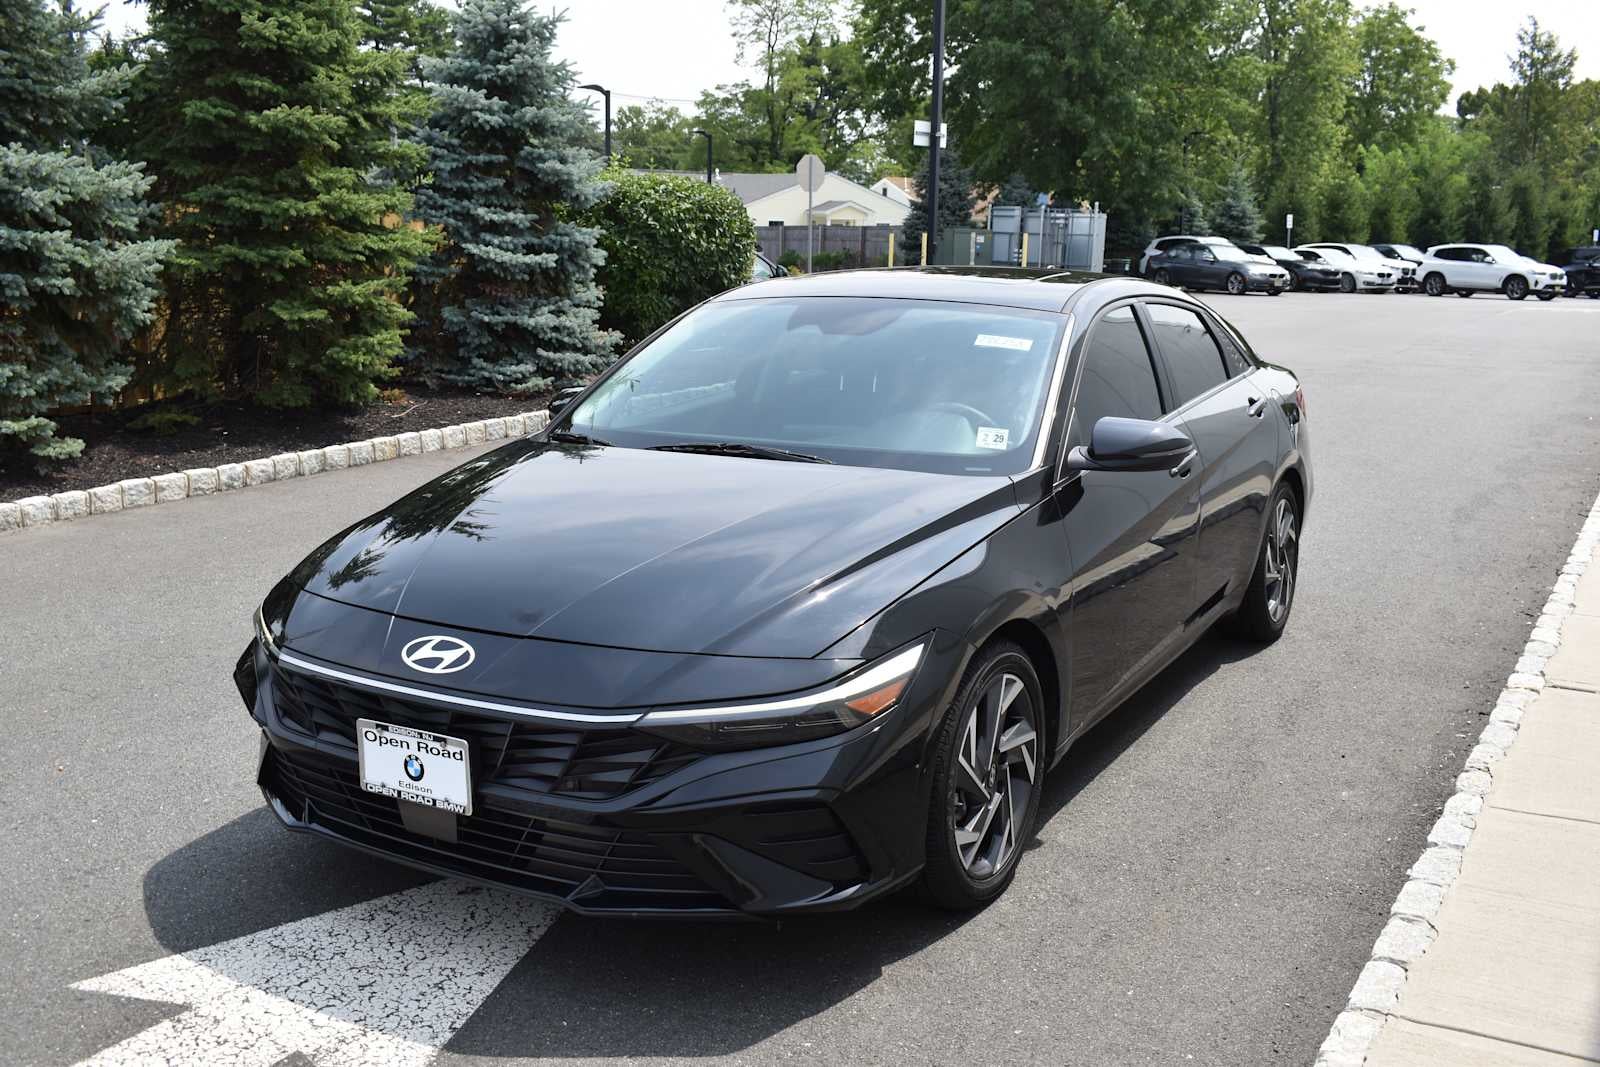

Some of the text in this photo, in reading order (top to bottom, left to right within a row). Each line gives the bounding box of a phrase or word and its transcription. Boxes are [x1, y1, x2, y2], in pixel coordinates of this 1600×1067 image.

[993, 434, 1004, 443] 29
[364, 730, 410, 750] Open
[417, 741, 464, 761] Road
[366, 783, 464, 814] OPEN ROAD BMW
[398, 780, 432, 795] Edison
